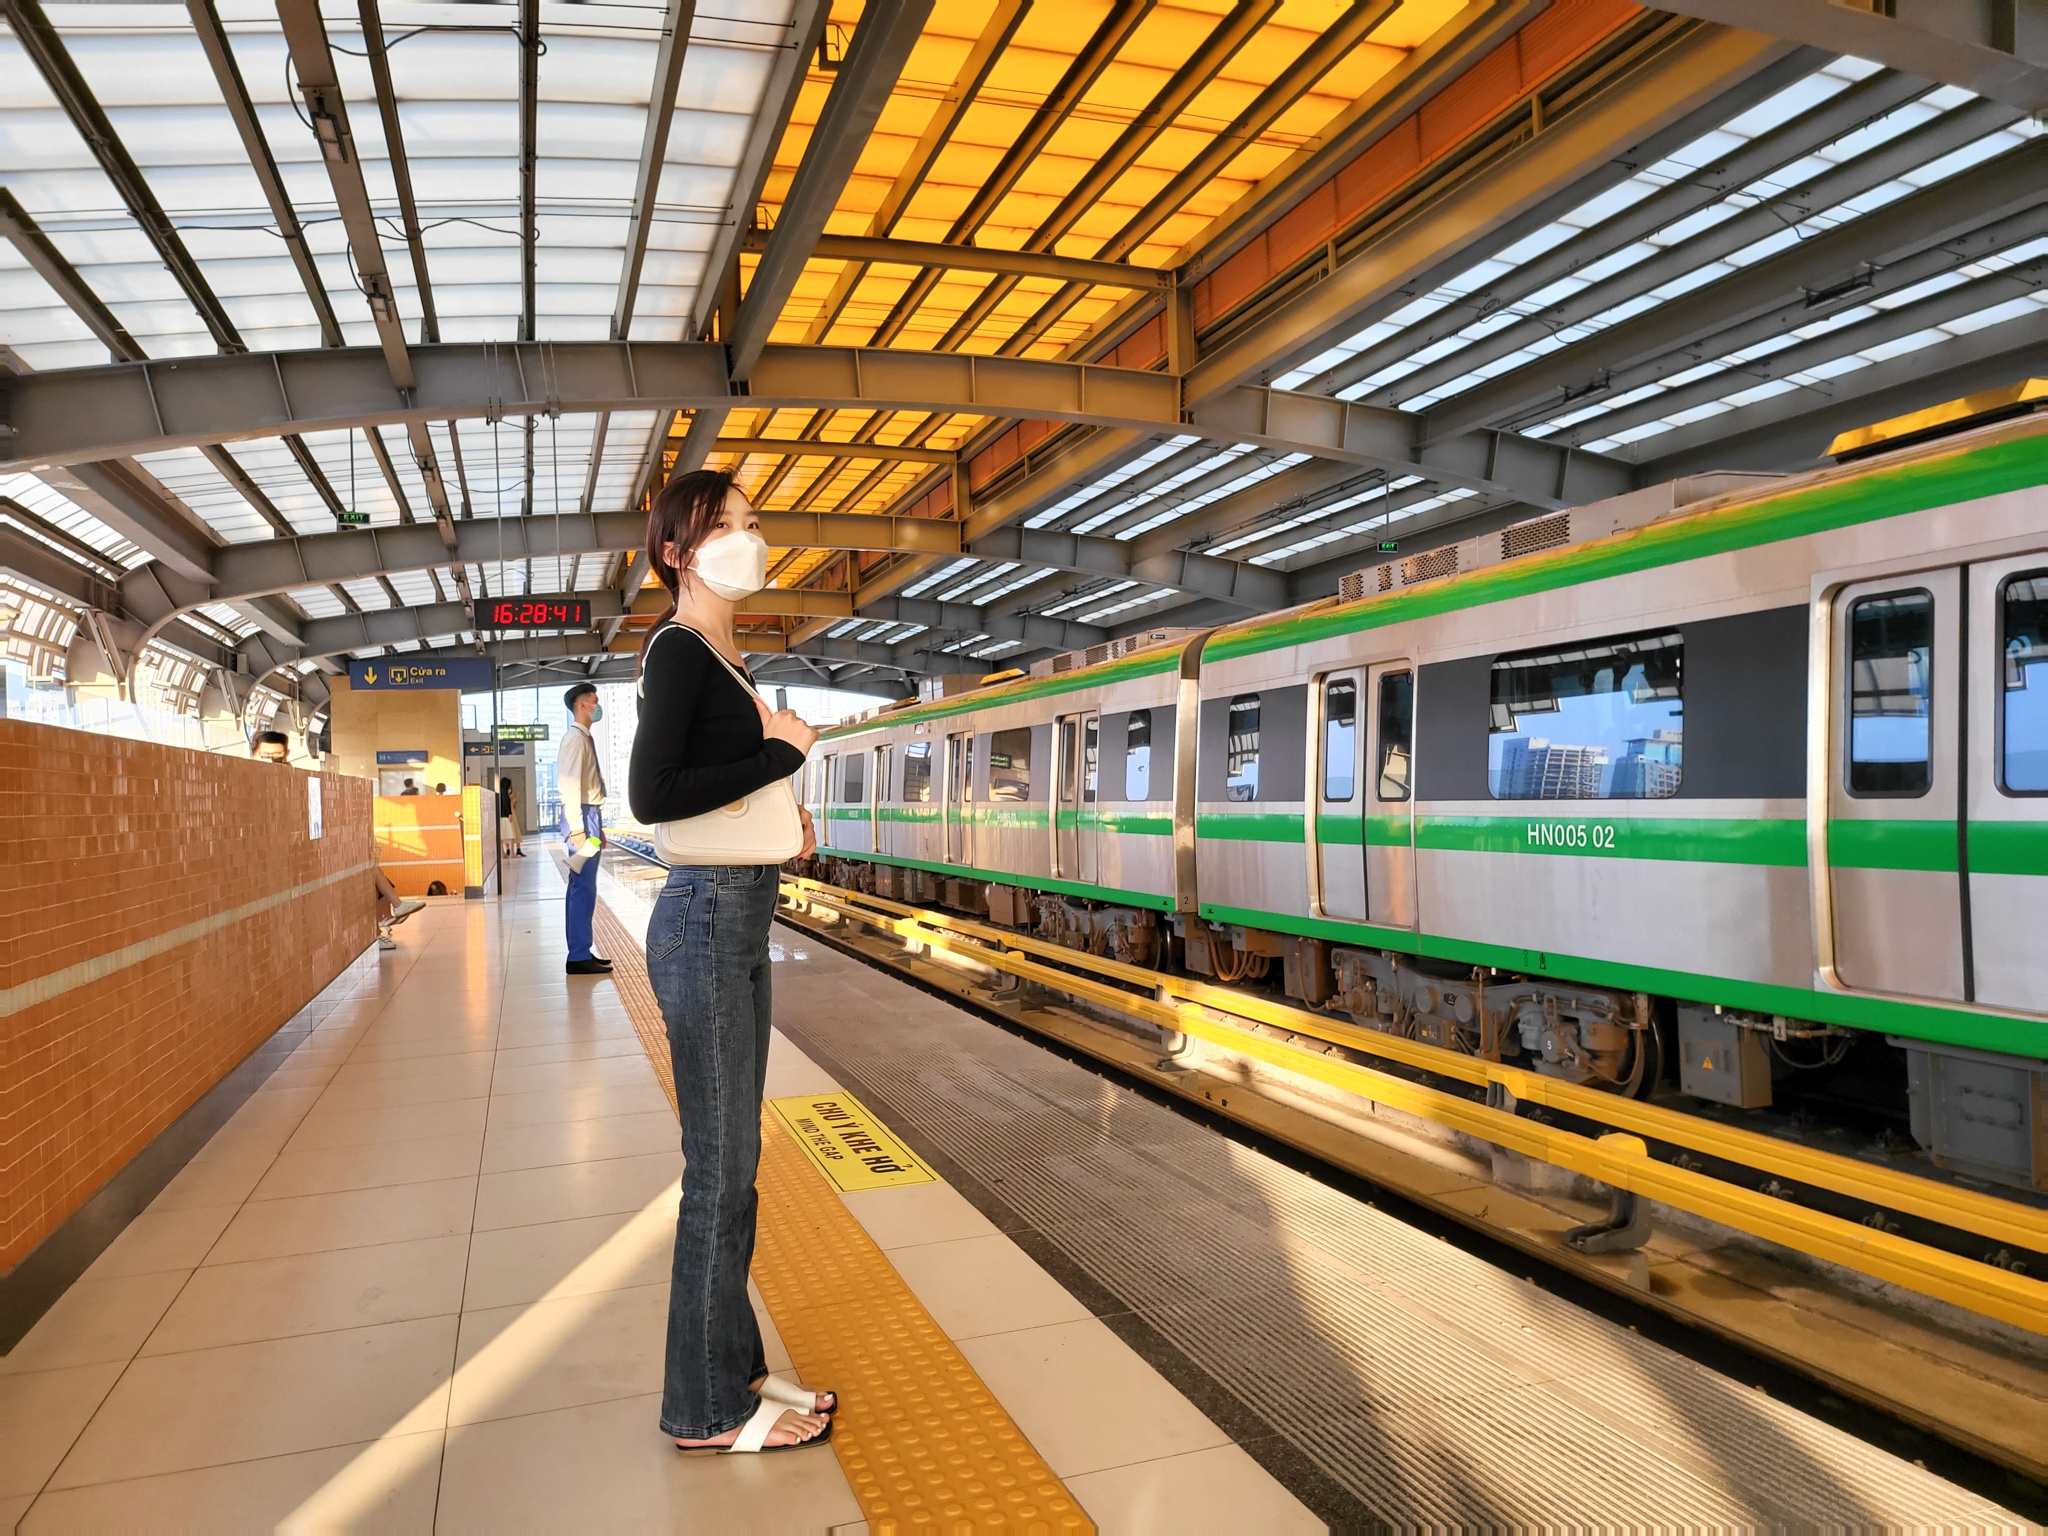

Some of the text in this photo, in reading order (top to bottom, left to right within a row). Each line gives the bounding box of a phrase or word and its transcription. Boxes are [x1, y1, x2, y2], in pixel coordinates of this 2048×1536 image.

[493, 603, 580, 625] 16:28:41
[410, 666, 446, 676] Cửa ra
[1527, 823, 1615, 849] HN005 02
[1183, 896, 1189, 905] 2
[1547, 1040, 1552, 1050] 5
[795, 1118, 844, 1160] MIND THE GAP
[811, 1102, 914, 1173] CHÚ Ý KHE HỞ
